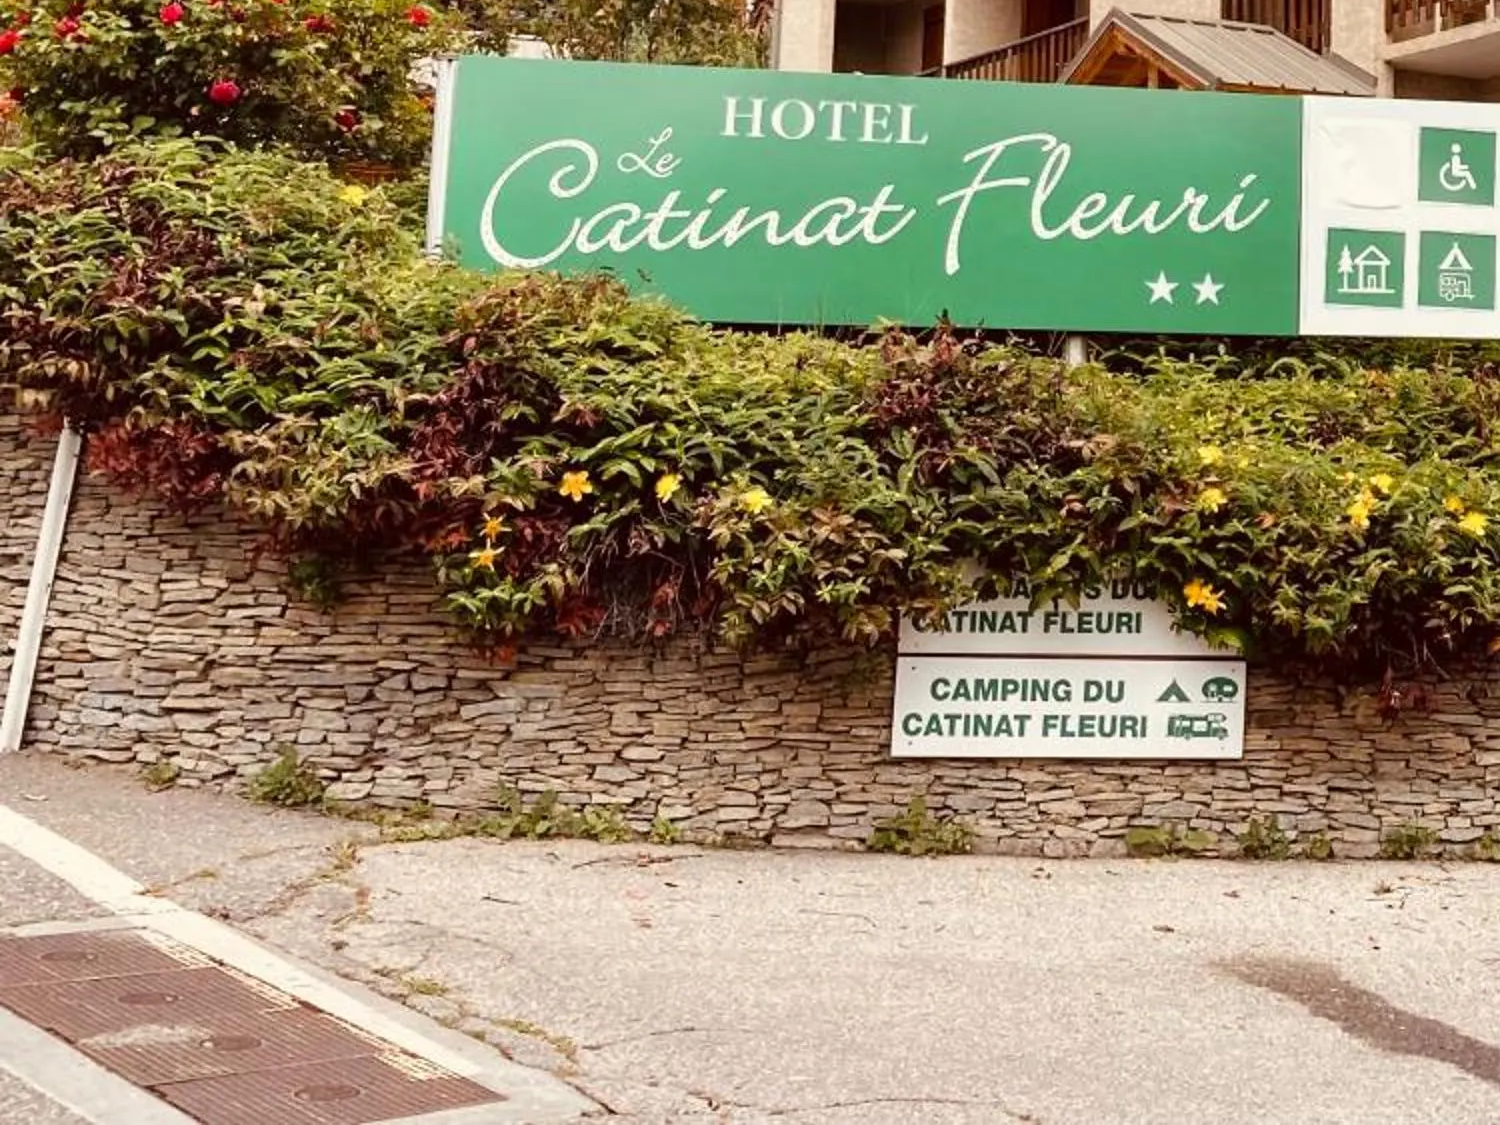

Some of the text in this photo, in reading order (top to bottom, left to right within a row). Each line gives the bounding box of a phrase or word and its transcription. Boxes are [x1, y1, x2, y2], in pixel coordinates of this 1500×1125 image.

[720, 95, 929, 146] HOTEL
[616, 126, 682, 178] Le
[479, 132, 1271, 277] Catinat Fleuri
[1042, 611, 1142, 634] FLEURI
[930, 677, 1125, 703] CAMPING DU
[902, 713, 1148, 739] CATINAT FLEURI
